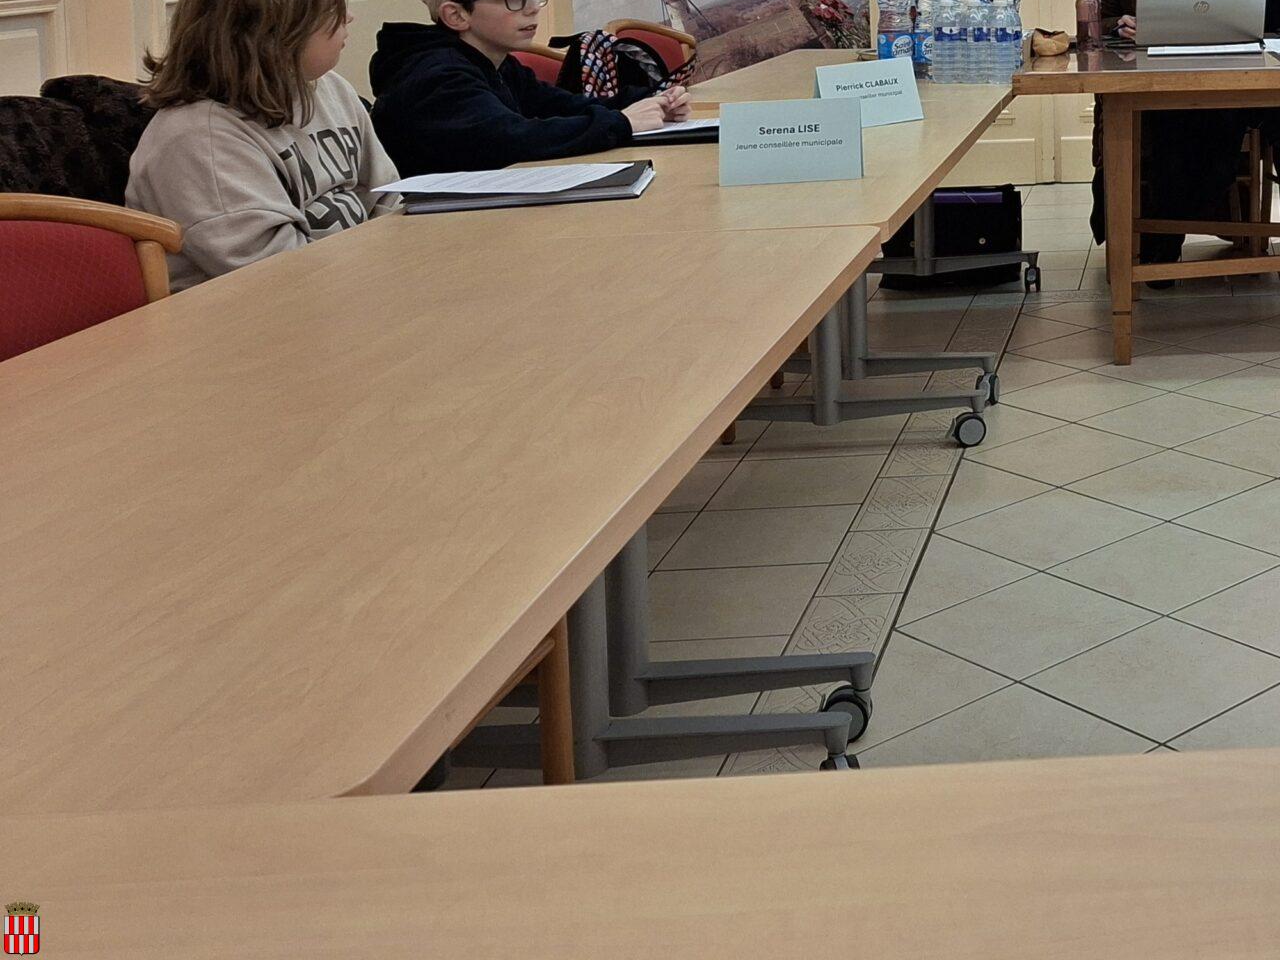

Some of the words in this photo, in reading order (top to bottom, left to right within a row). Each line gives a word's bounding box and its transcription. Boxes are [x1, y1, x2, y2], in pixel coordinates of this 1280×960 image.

[836, 83, 864, 92] Pierrick
[865, 78, 899, 88] CLABAUX
[758, 126, 796, 136] Serena
[798, 123, 820, 133] LISE
[758, 140, 800, 149] conseillère
[801, 138, 843, 147] municipale
